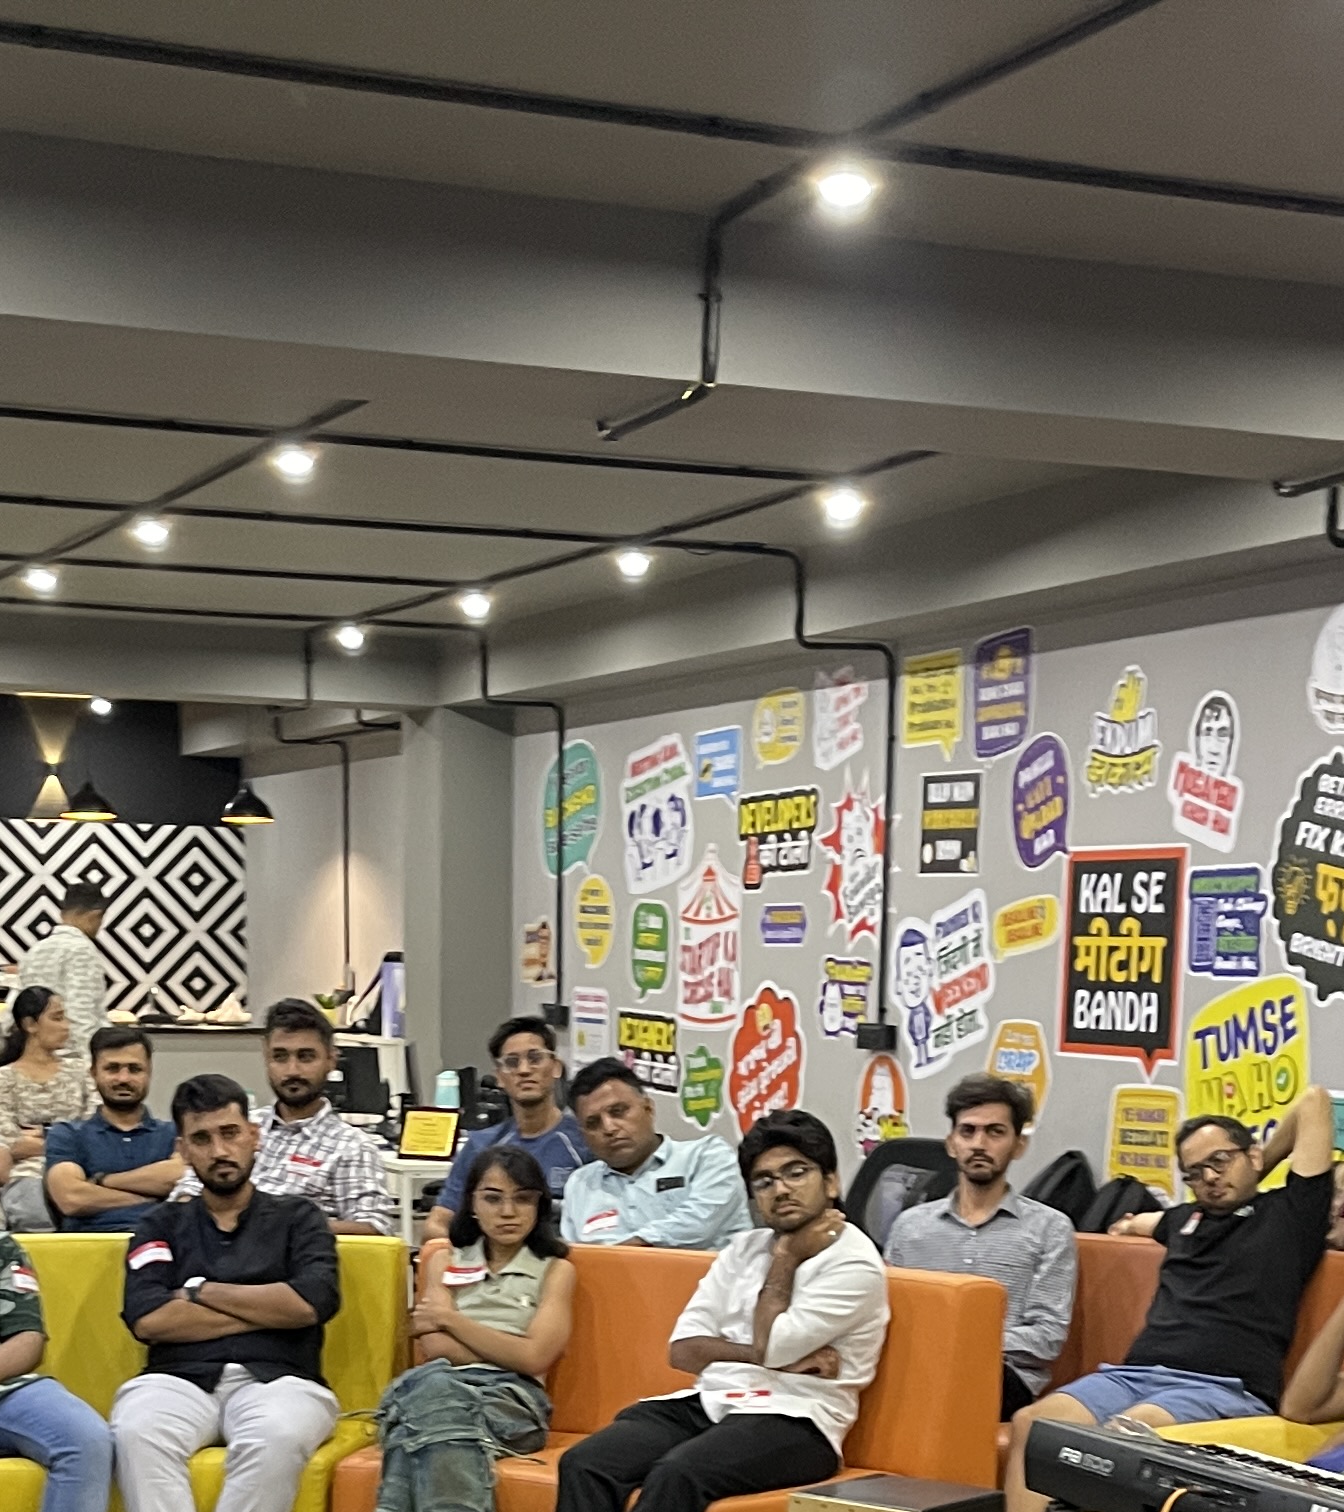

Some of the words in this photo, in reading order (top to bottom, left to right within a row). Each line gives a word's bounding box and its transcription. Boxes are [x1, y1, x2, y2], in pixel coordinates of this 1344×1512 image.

[1294, 821, 1332, 853] FIX
[1079, 873, 1126, 913] KAL
[1131, 871, 1167, 914] SE
[1073, 989, 1159, 1033] BANDH
[1193, 994, 1297, 1070] TUMSE
[1249, 1053, 1299, 1113] HO
